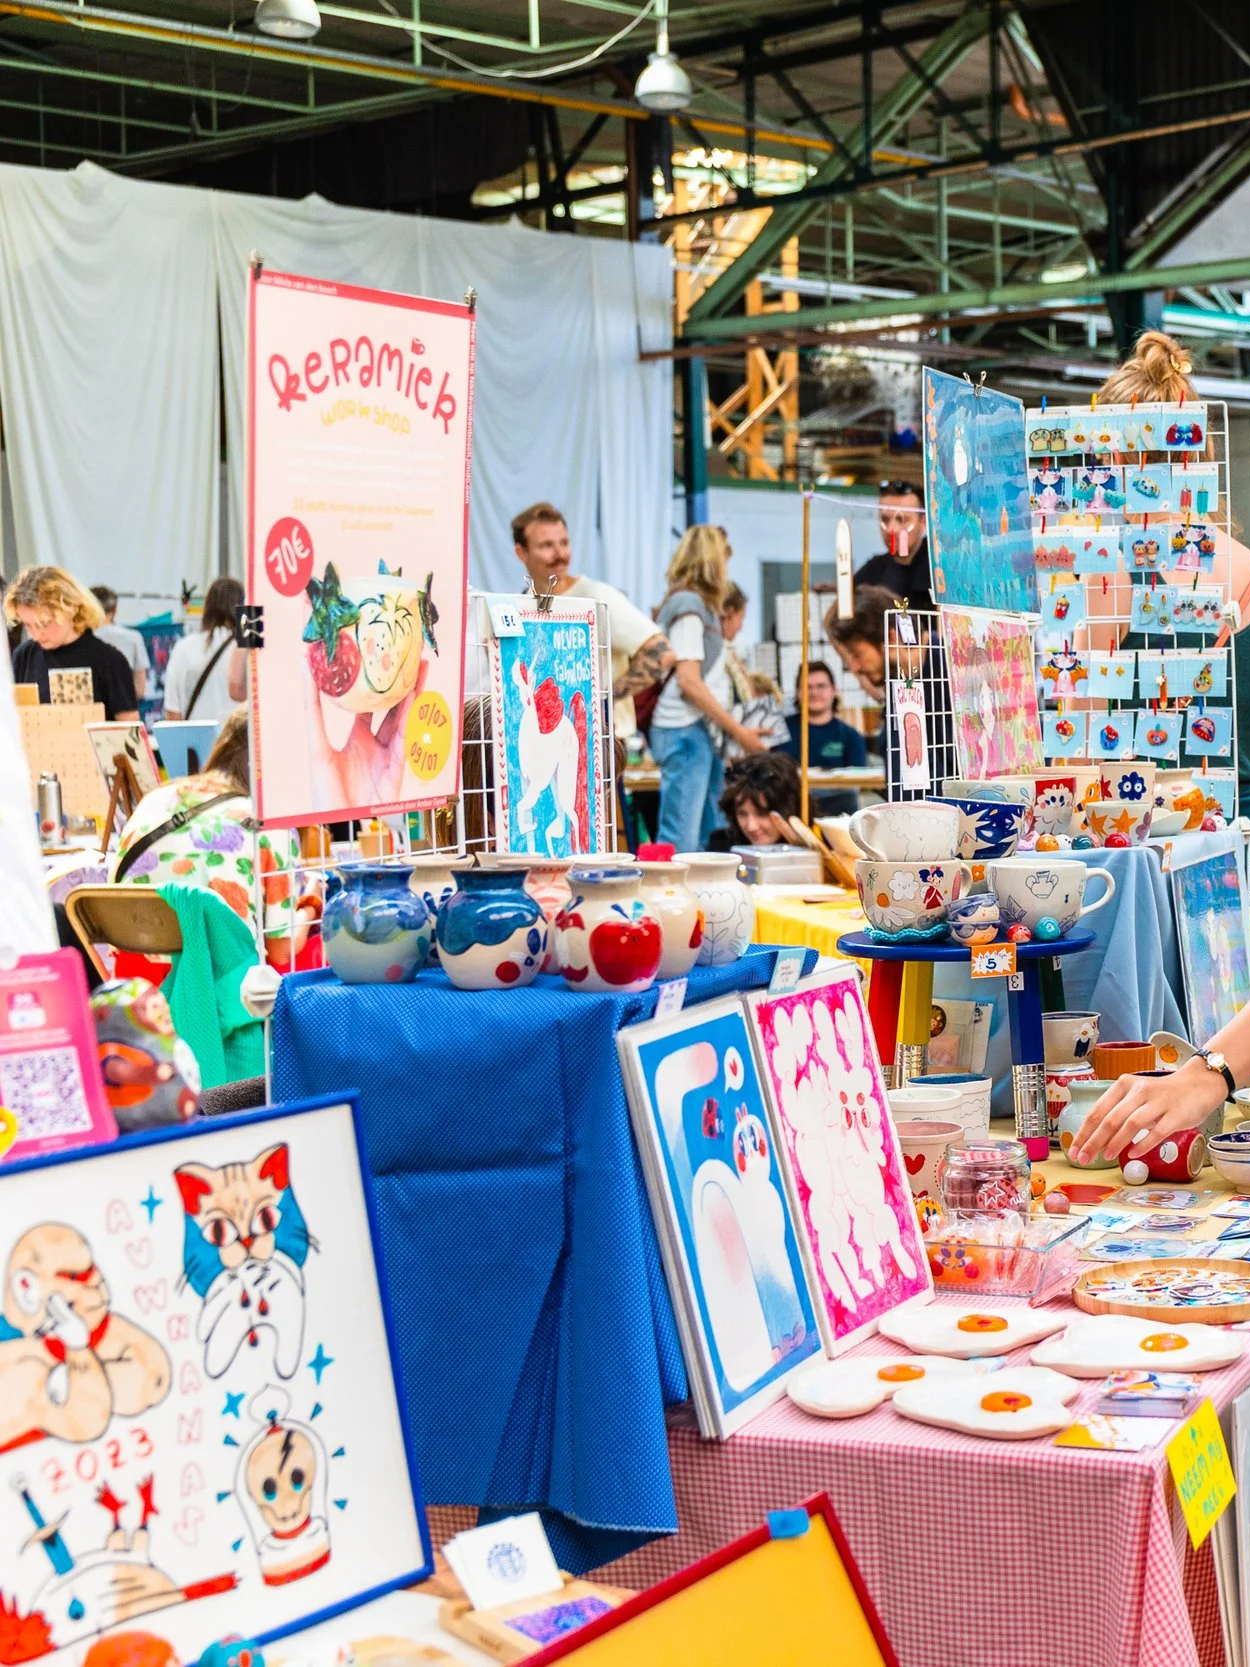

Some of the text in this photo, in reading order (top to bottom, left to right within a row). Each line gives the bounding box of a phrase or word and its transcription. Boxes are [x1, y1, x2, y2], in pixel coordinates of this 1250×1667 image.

[267, 524, 311, 585] 70€
[553, 627, 586, 651] NEVER
[985, 958, 997, 969] 5
[40, 1427, 155, 1496] 2023
